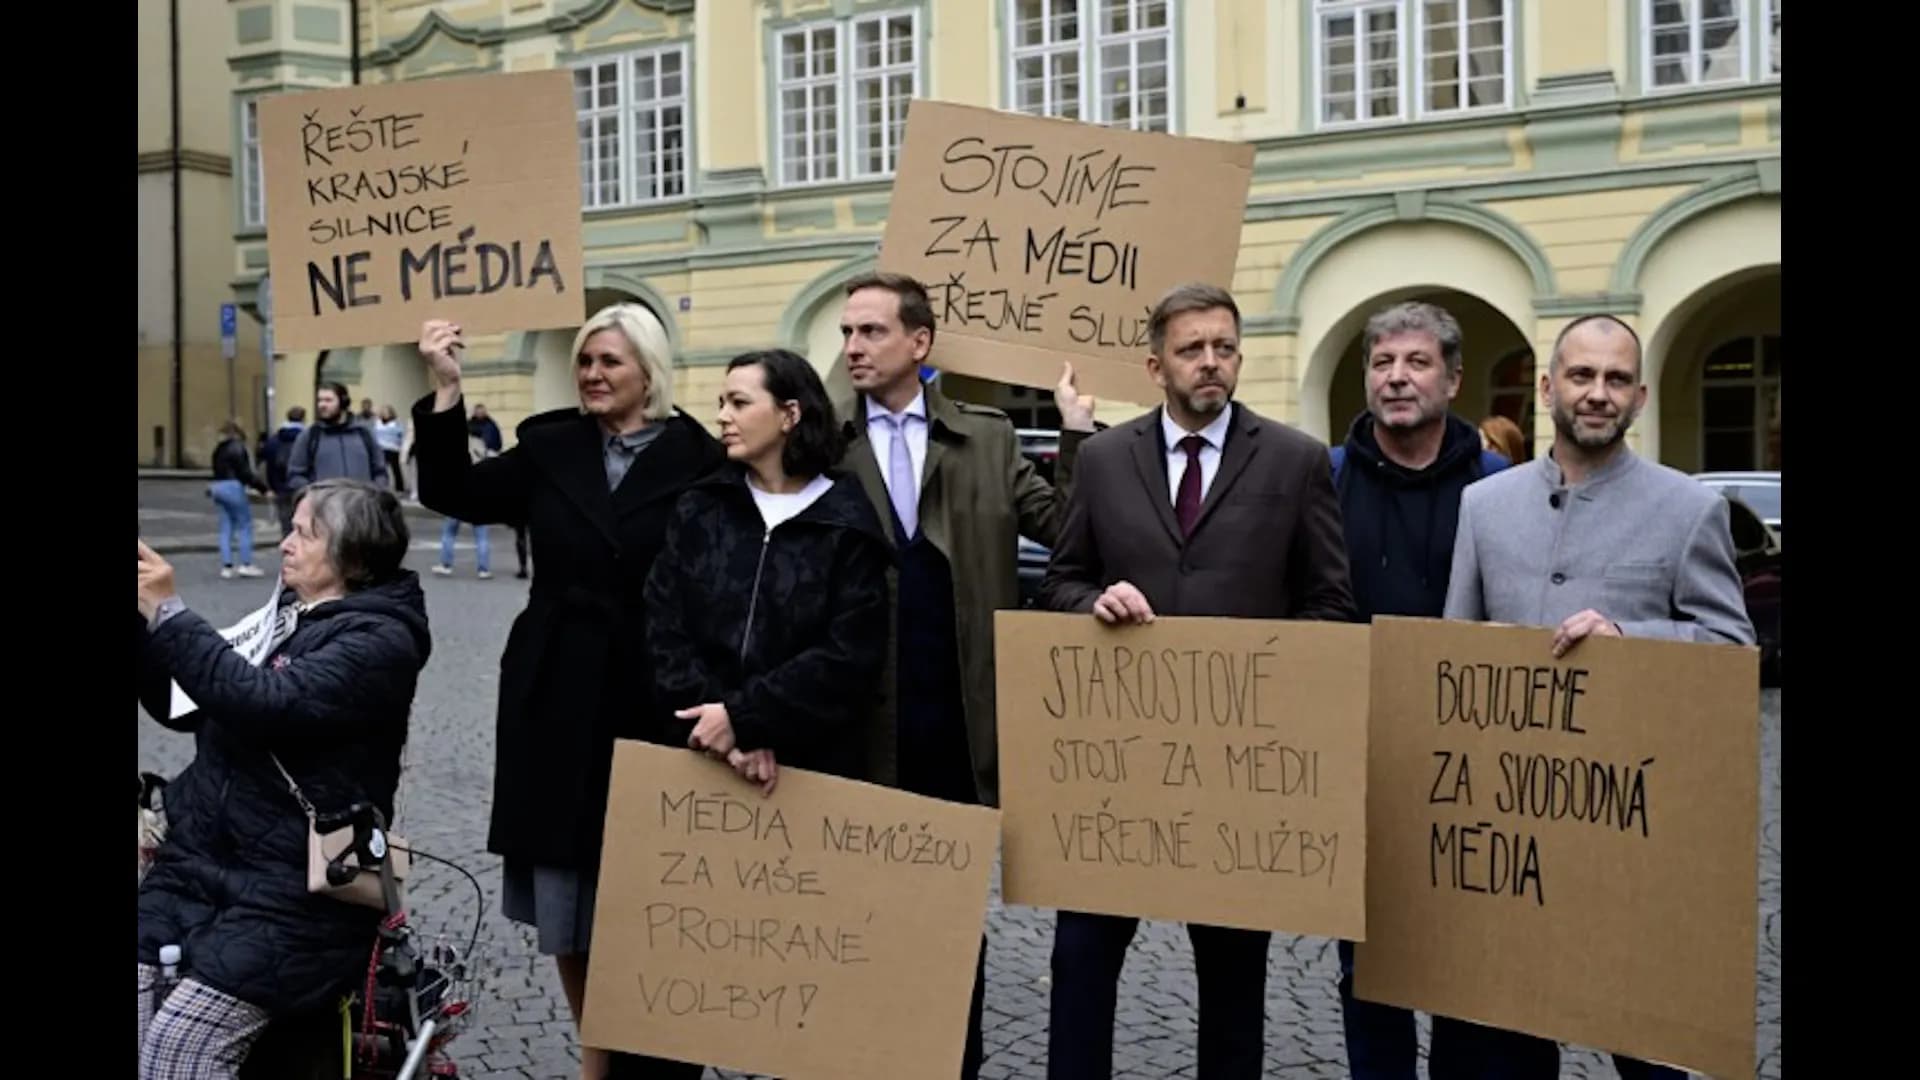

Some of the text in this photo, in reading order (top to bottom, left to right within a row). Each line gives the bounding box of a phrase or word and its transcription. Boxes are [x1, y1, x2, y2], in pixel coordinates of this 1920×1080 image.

[302, 105, 424, 166] ŘEŠTE
[307, 140, 470, 205] KRAJSKÉ
[940, 137, 1156, 219] STOJÍME
[309, 205, 452, 244] SILNICE
[925, 216, 1138, 290] ZA MÉDII
[307, 225, 565, 316] NE MÉDIA
[923, 271, 1150, 347] EŘEJNÉ SLUŽ
[1043, 636, 1279, 728] STAROSTOVÉ
[1437, 660, 1589, 734] BOJUJEME
[1050, 735, 1318, 798] STOJÍ ZA MÉDII
[1429, 751, 1655, 838] ZA SVOBODNÁ
[660, 790, 971, 871] MÉDIA NEMŮŽOU
[1052, 797, 1339, 888] VEŘEJNÉ SLUŽBY
[1431, 822, 1544, 906] MÉDIA
[659, 851, 826, 896] ZA VAŠE
[645, 903, 871, 964] PROHRANÉ
[638, 973, 818, 1029] VOLBY!
